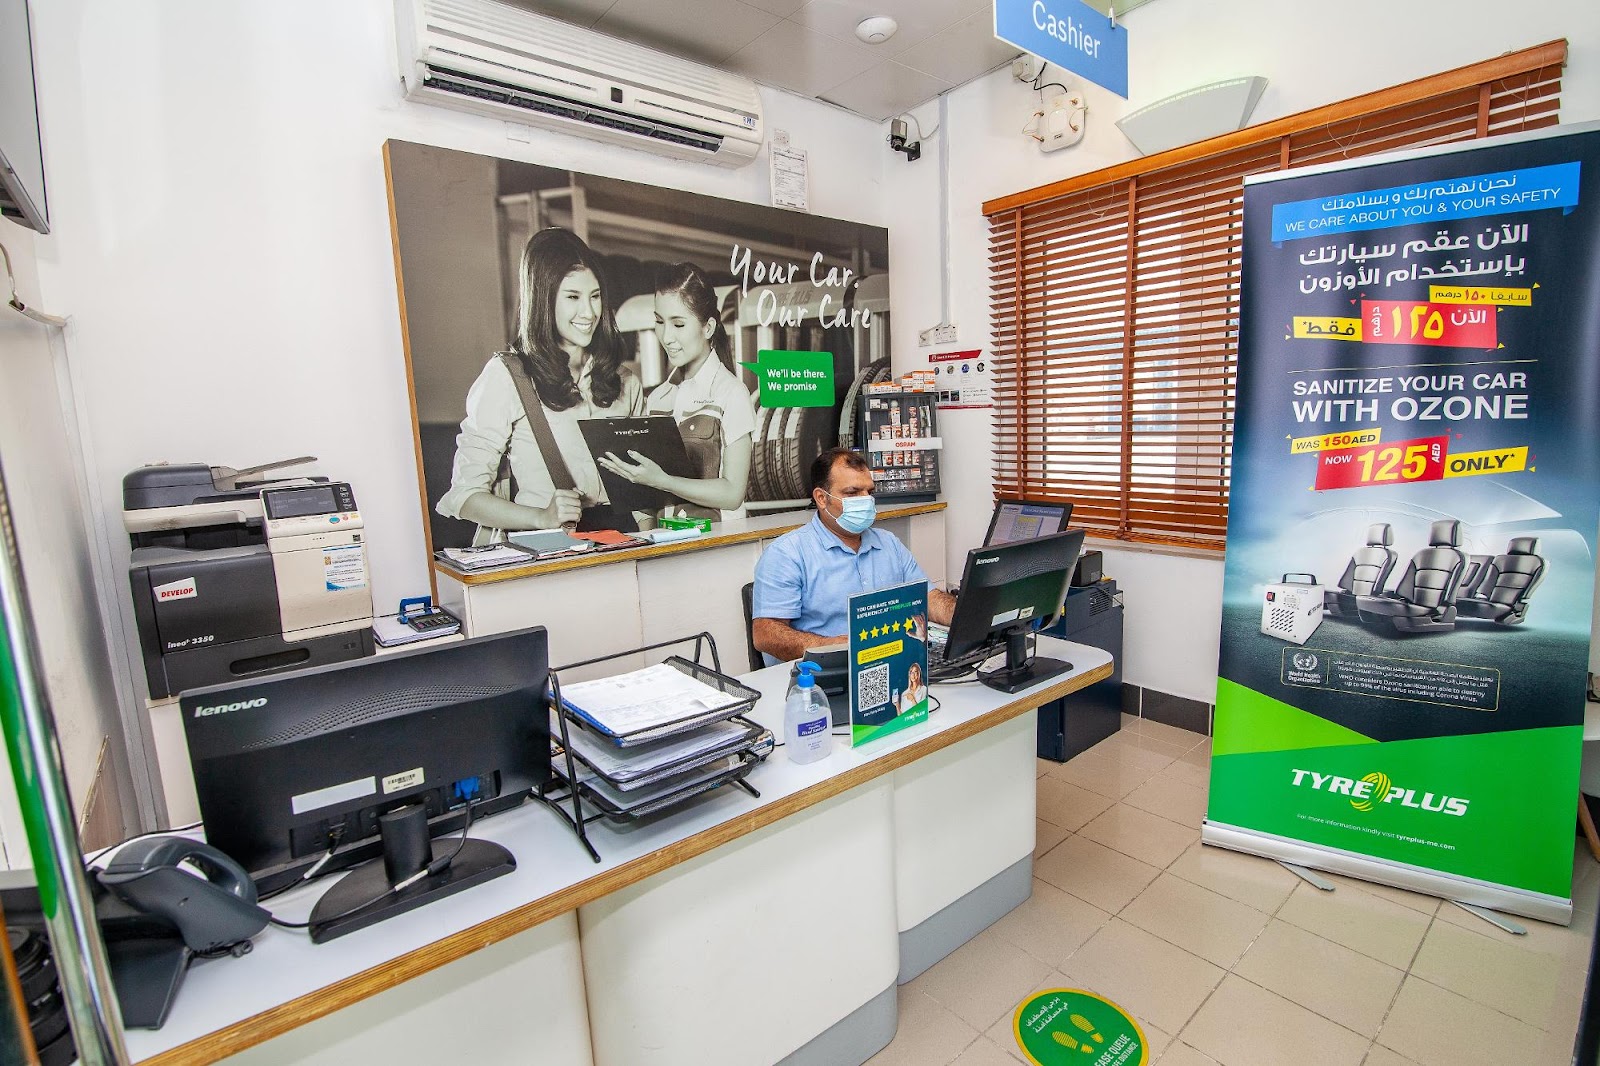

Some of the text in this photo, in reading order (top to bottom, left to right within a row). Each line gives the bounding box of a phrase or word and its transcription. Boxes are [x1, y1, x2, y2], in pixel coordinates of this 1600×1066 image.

[1032, 0, 1101, 58] Cashier
[1404, 187, 1428, 200] بك
[1430, 181, 1476, 199] نهتم
[1479, 175, 1516, 192] نحن
[1286, 188, 1561, 232] WE CARE ABOUT YOU & YOUR SAFETY
[1300, 223, 1529, 266] الآن عقم سيارتك
[730, 244, 800, 298] Your
[810, 252, 859, 289] Car.
[1300, 254, 1525, 294] بإستخدام الأوزون
[1465, 289, 1486, 300] ١٥٠
[756, 289, 808, 328] Our
[819, 294, 872, 330] Care
[1450, 308, 1486, 326] الآن
[1372, 306, 1382, 337] درهم
[1392, 306, 1444, 340] ١٢٥
[767, 368, 826, 379] We'll be there.
[768, 382, 817, 392] We promise
[1293, 372, 1527, 396] SANITIZE YOUR CAR
[1292, 394, 1528, 422] WITH OZONE
[1296, 440, 1320, 450] WAS
[1325, 454, 1352, 465] NOW
[1356, 444, 1428, 482] 125
[1432, 443, 1440, 463] AED
[976, 556, 1000, 566] lenovo
[162, 588, 194, 598] DEVELOP
[192, 635, 214, 644] 3350
[1408, 689, 1434, 698] including
[1436, 692, 1458, 700] Corona
[1460, 694, 1478, 702] Virus.
[1461, 688, 1486, 698] destroy
[194, 697, 268, 718] lenovo
[1308, 816, 1324, 824] more
[1326, 820, 1361, 830] information
[1362, 826, 1382, 836] kindly
[1396, 834, 1456, 850] tyreplus-me.com
[1108, 1034, 1130, 1055] QUEUE
[1118, 1042, 1138, 1062] DISTANCE
